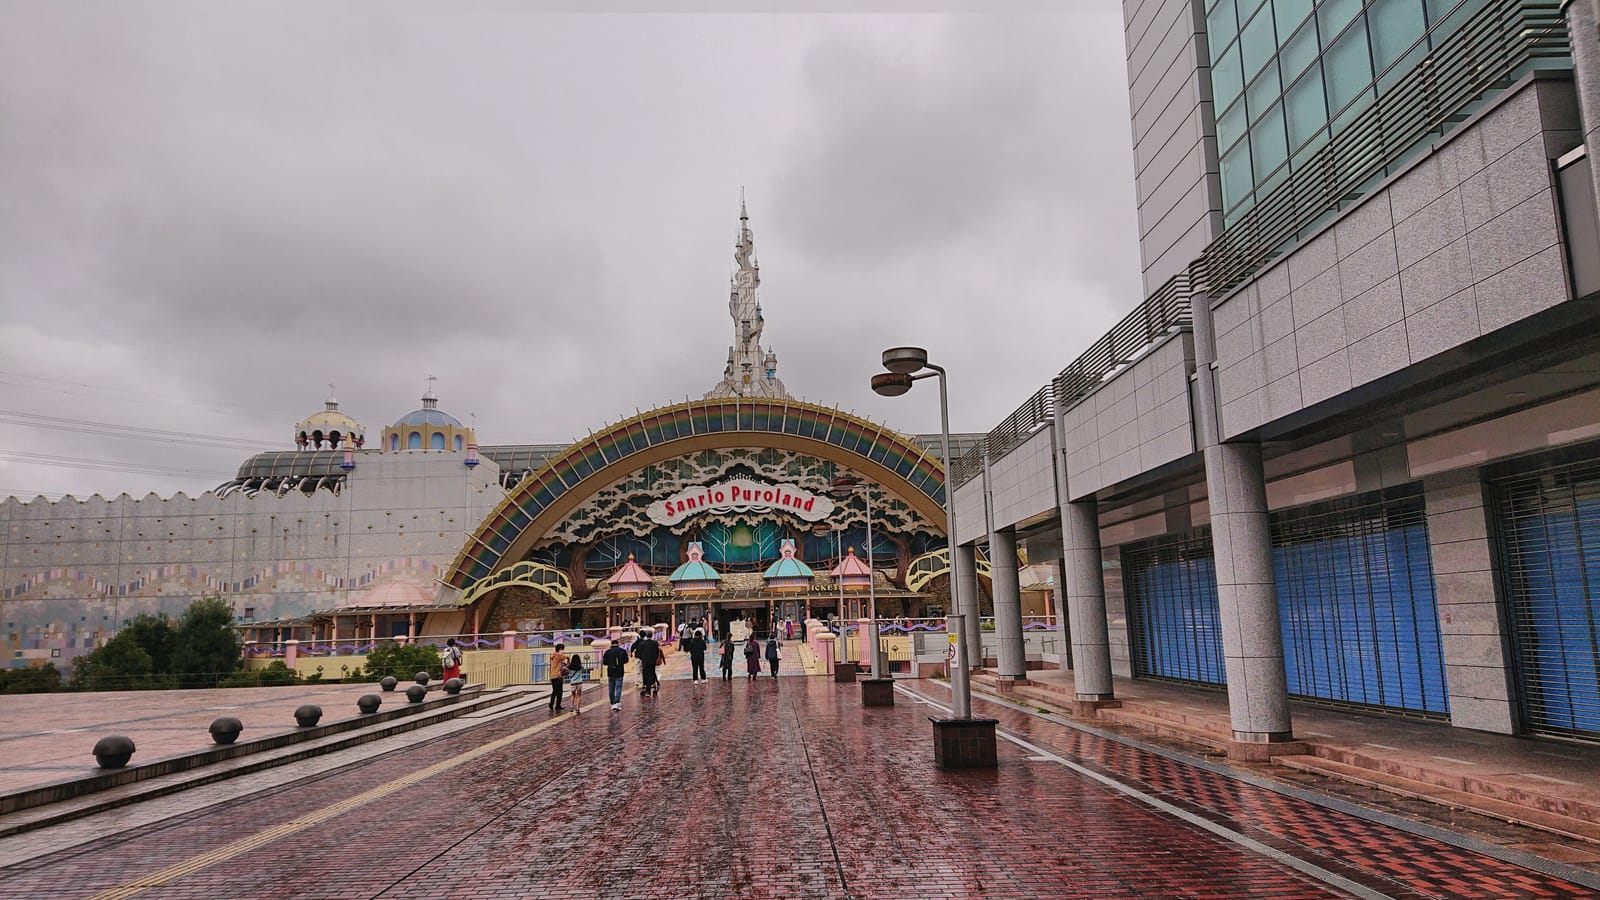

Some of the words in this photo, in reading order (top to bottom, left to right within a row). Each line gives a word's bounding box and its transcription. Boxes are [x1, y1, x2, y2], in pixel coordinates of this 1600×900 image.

[664, 489, 725, 517] Sanrio
[731, 486, 816, 512] Puroland
[637, 590, 676, 598] TICKETS
